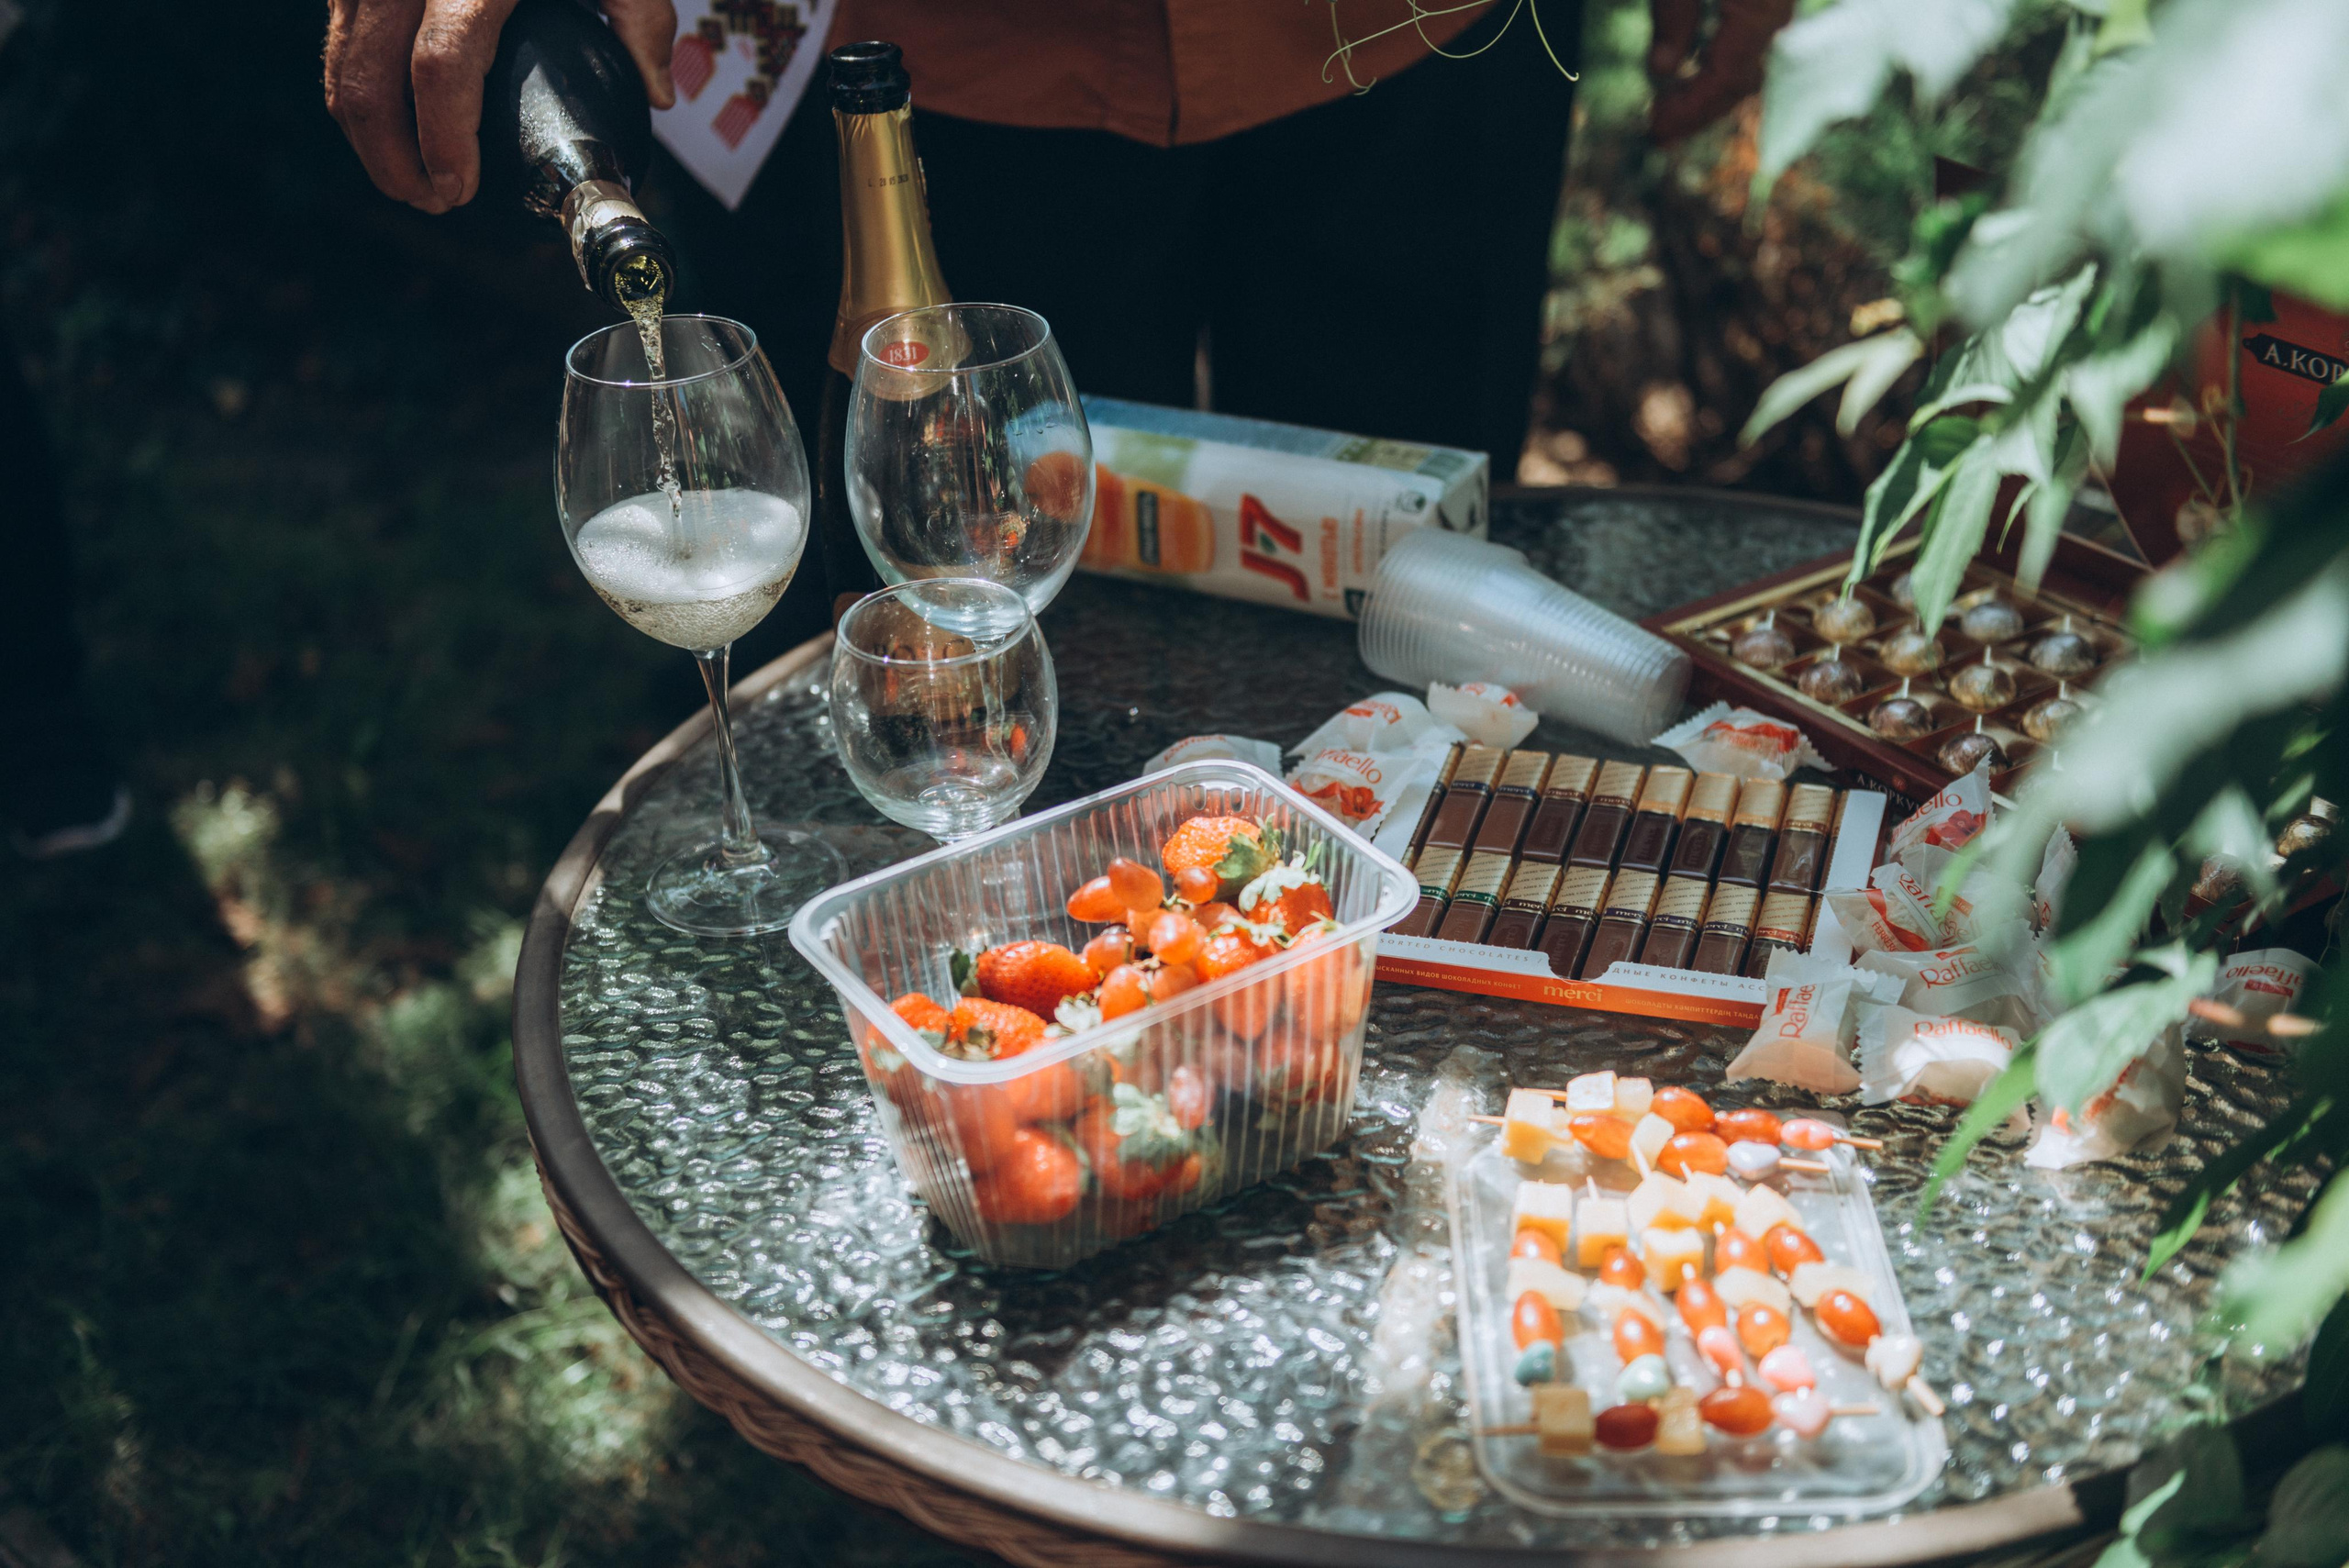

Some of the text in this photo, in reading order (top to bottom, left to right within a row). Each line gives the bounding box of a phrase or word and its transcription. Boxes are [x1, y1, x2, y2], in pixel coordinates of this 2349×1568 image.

[1240, 492, 1311, 603] J7
[1379, 937, 1431, 951] SORTED
[1439, 944, 1530, 962] CHOCOLATES
[1416, 970, 1441, 981] ВИДОВ
[1442, 973, 1492, 987] ШОКОЛАДНЫХ
[1493, 981, 1522, 991] КОНФЕТ
[1660, 973, 1729, 988] КОНФЕТЫ
[1542, 983, 1603, 1003] merci
[1914, 1019, 2013, 1051] Raffaello
